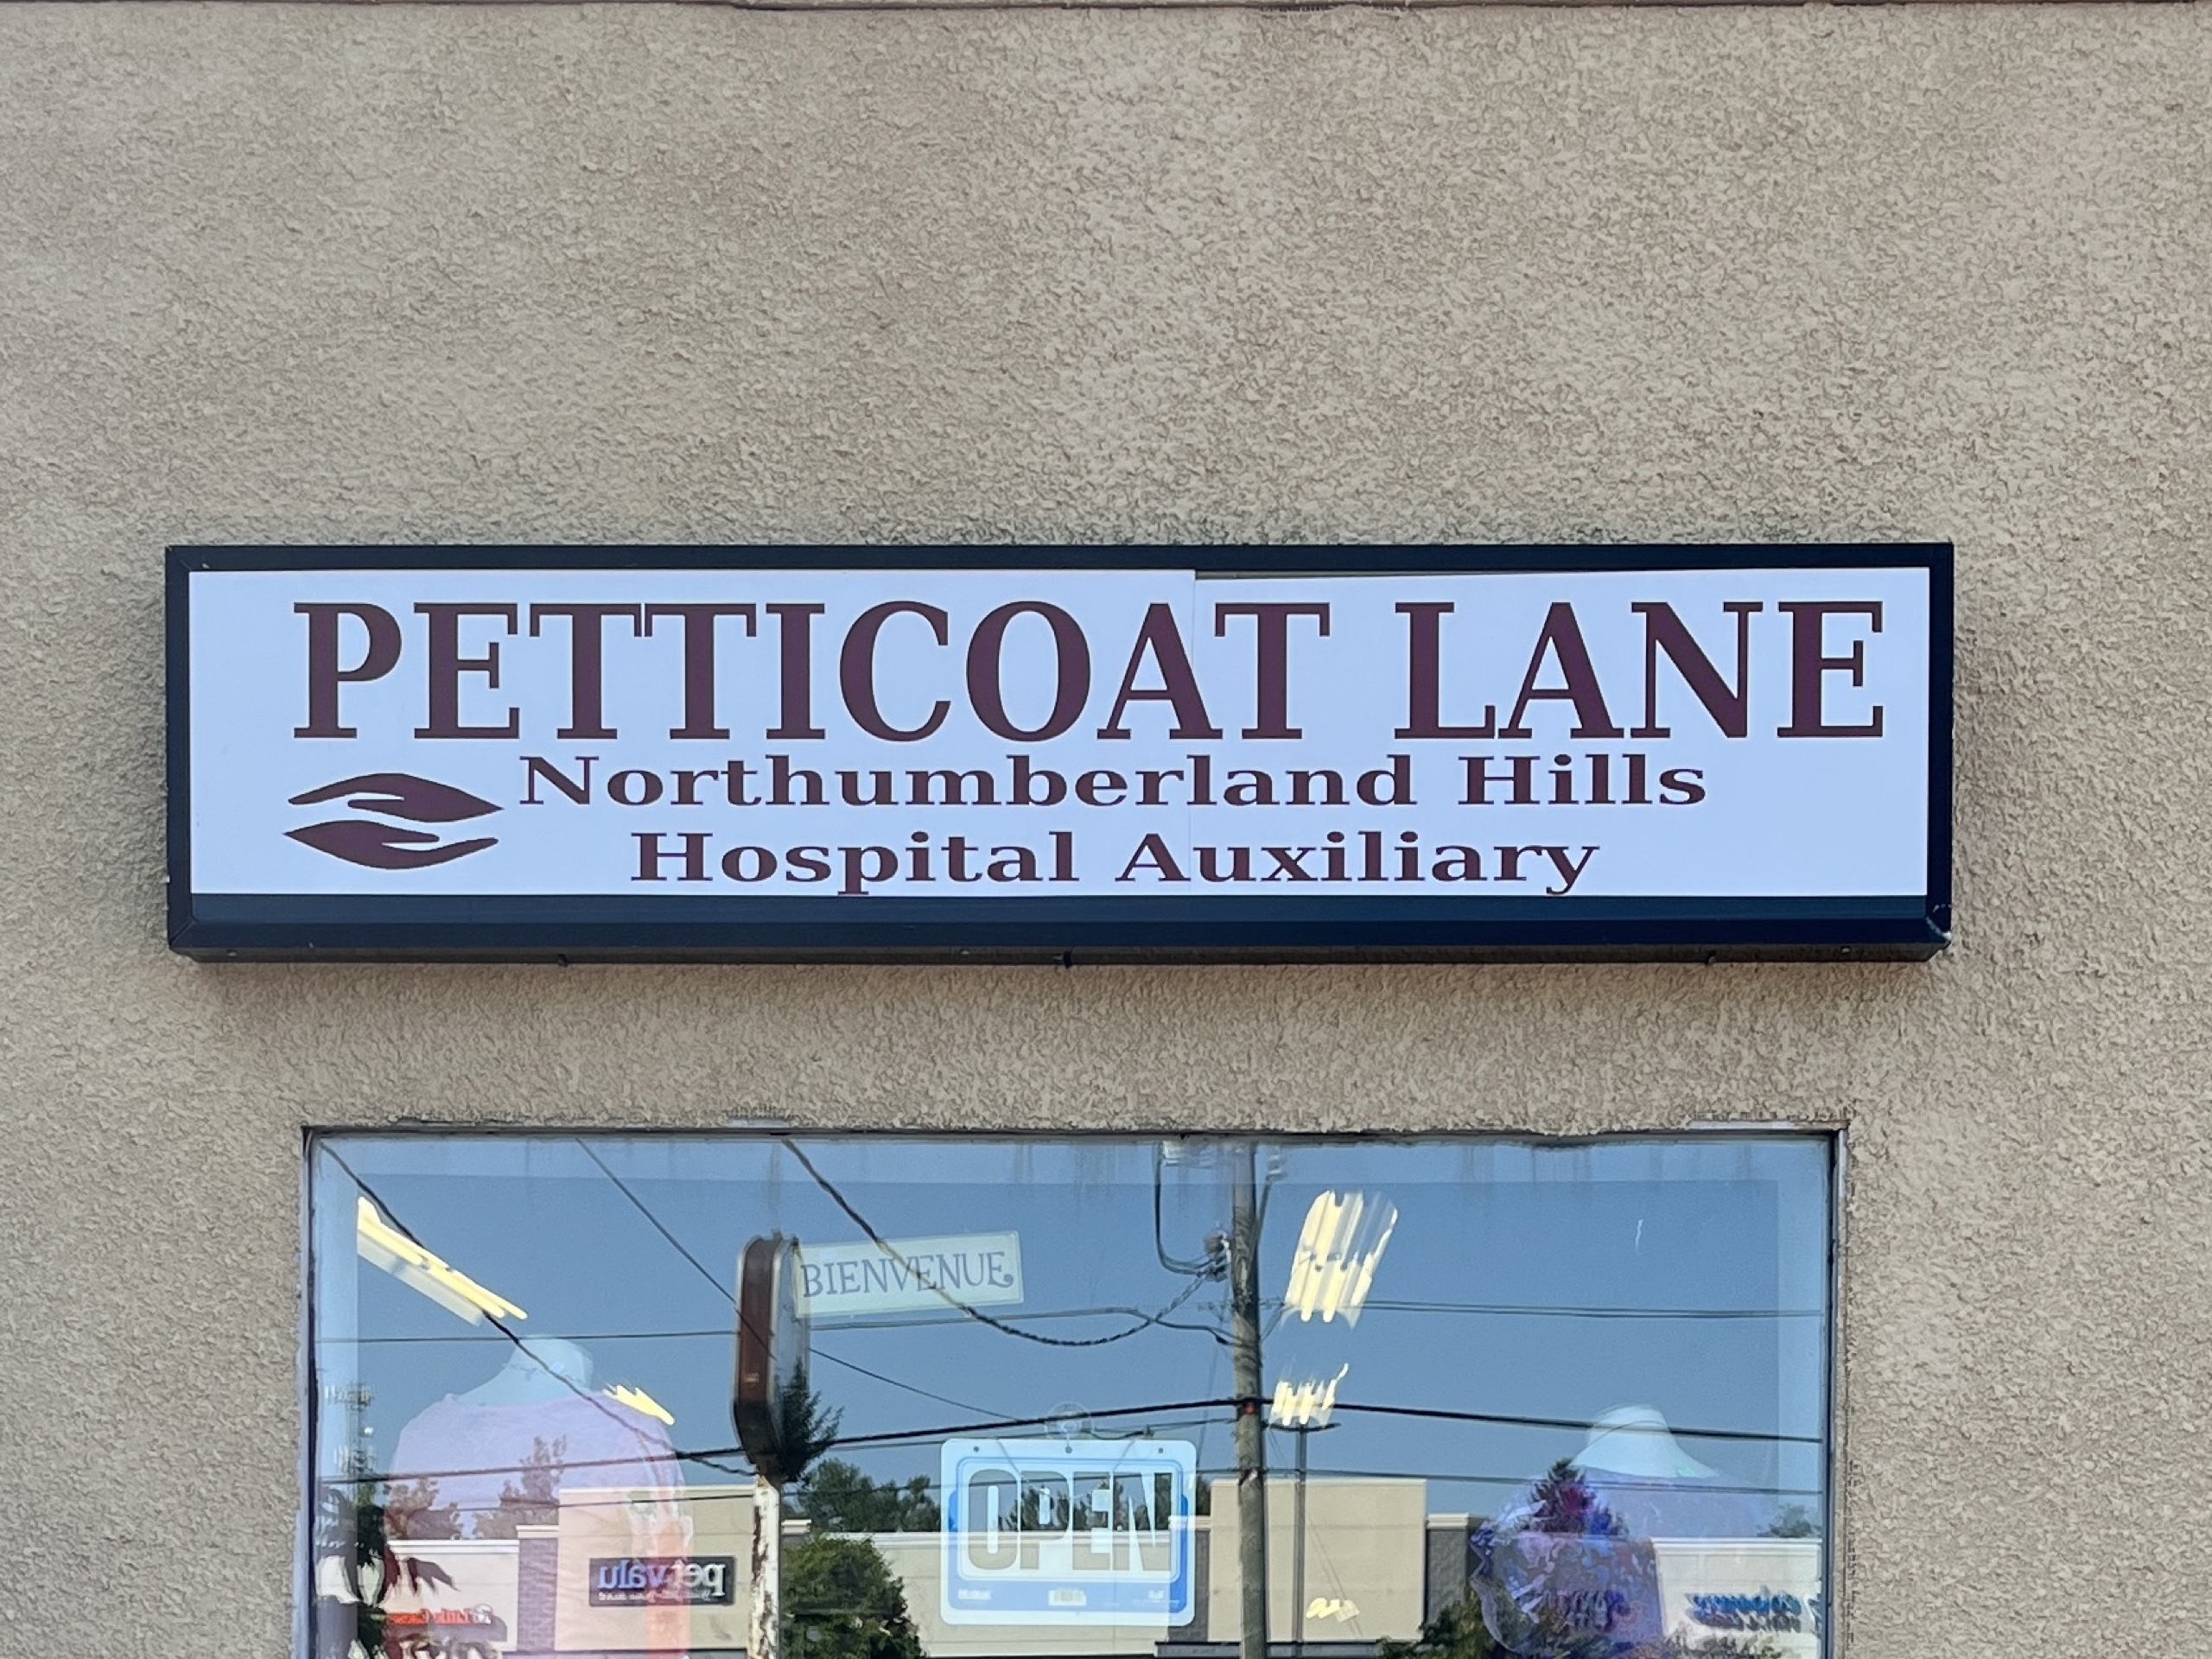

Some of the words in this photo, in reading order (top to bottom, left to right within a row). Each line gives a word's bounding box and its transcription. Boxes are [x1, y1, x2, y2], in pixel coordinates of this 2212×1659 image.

[294, 601, 1331, 741] PETTICOAT
[1395, 601, 1884, 739] LANE
[519, 754, 1418, 806] Northumberland
[1458, 753, 1707, 805] Hills
[631, 830, 1079, 897] Hospital
[1114, 830, 1600, 895] Auxiliary
[800, 1251, 1014, 1297] BIENVENUE
[968, 1468, 1172, 1572] OPEN
